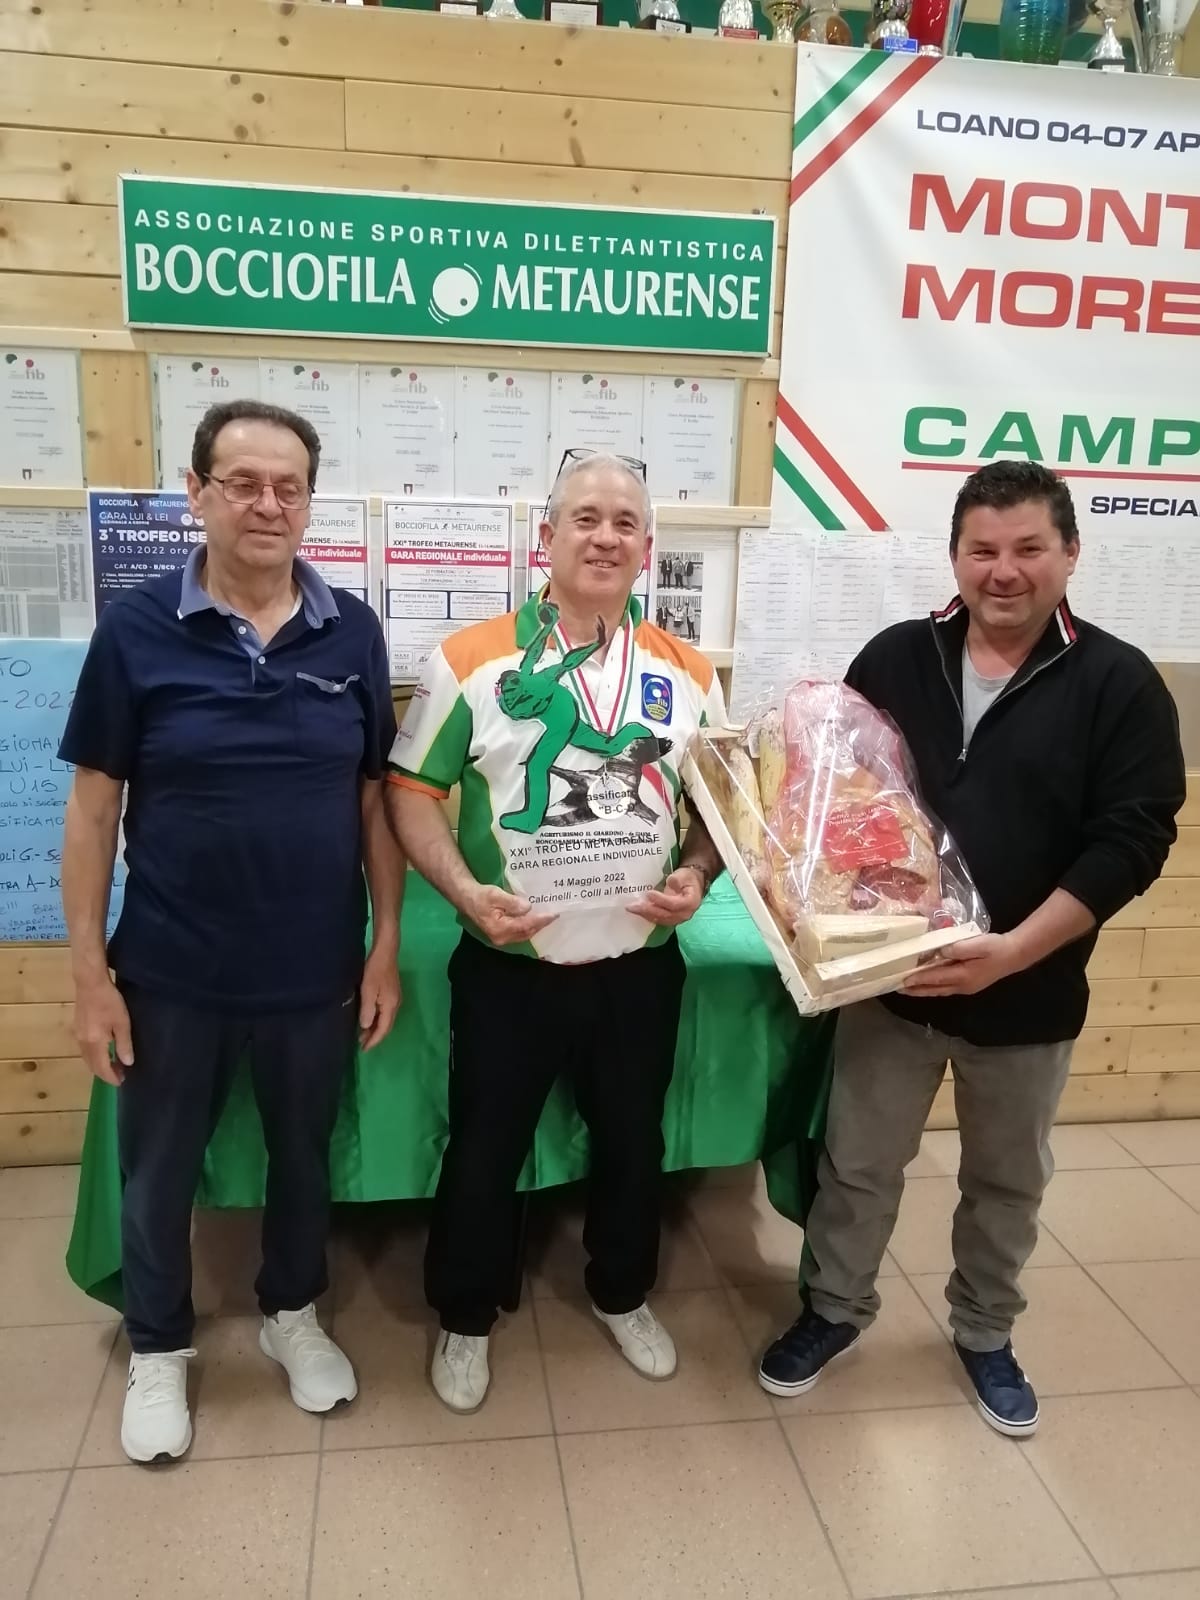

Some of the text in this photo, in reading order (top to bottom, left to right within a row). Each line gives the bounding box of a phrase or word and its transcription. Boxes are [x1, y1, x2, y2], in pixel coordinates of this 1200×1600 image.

[916, 109, 1040, 140] LOANO
[1047, 121, 1148, 150] 04-07
[908, 173, 1200, 250] MONT
[134, 208, 765, 262] ASSOCIAZIONE SPORTIVA DILETTANTISTICA
[134, 242, 760, 320] BOCCIOFILA METAURENSE
[901, 263, 1200, 337] MORE
[903, 406, 1200, 467] CAMP
[98, 498, 189, 508] BOCCIOFILA METAURENS
[1090, 496, 1200, 517] SPECIA
[99, 511, 169, 522] GARA LUI & LEI
[311, 518, 357, 528] ETAURENSE
[395, 521, 502, 532] BOCCIOFILA METAURENSE
[116, 529, 181, 543] TROFEO
[183, 531, 208, 543] ISE
[101, 545, 166, 555] 29.05.2022
[317, 548, 362, 558] individuale
[434, 541, 478, 549] METAURENSE
[390, 550, 507, 562] GARA REGIONALE individuale
[49, 759, 77, 773] LE
[509, 833, 660, 857] XXI° TROFEO METAURENSE
[510, 846, 663, 871] GARA REGIONALE INDIVIDUALE
[553, 872, 626, 889] 14 Maggio 2022
[528, 891, 572, 905] Calcinelli
[580, 888, 602, 899] Colli
[615, 883, 653, 895] Metauro
